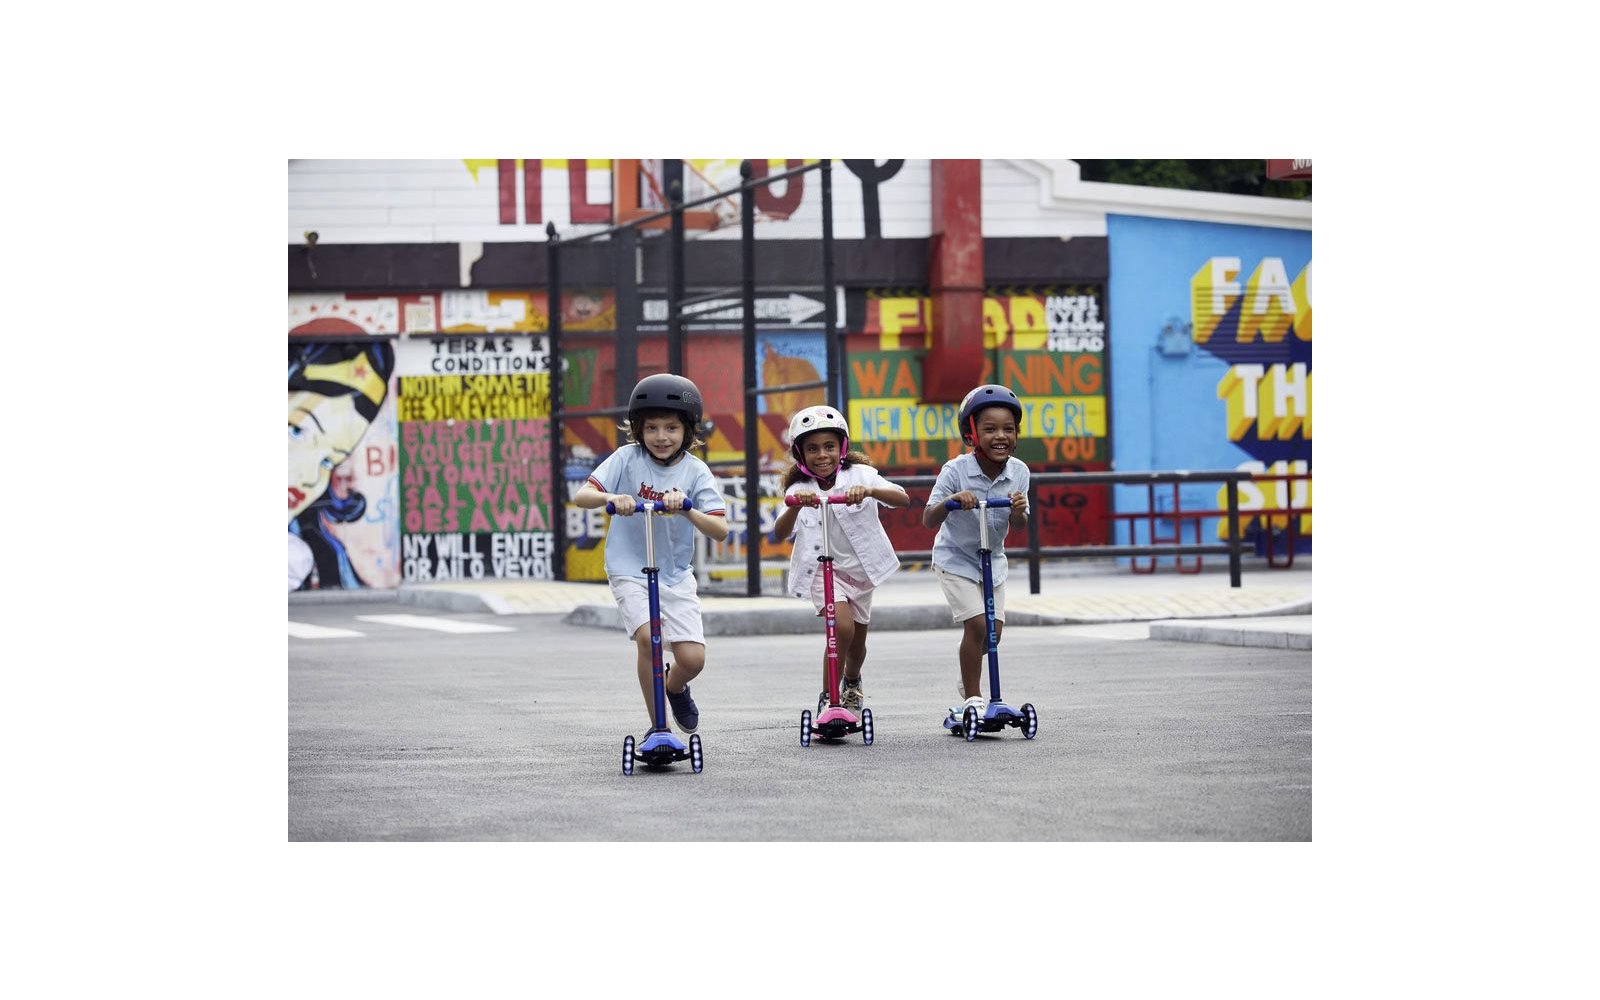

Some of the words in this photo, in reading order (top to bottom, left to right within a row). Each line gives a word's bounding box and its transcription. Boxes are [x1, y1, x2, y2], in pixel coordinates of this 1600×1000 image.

[879, 296, 1046, 350] FOD
[431, 339, 512, 354] TERMS
[531, 338, 543, 353] &
[432, 356, 550, 372] CONDITIONS
[861, 406, 900, 442] NEW
[908, 404, 960, 440] YOR
[863, 438, 937, 466] WILL
[1042, 436, 1096, 463] YOU
[470, 504, 552, 532] AWA
[403, 534, 431, 559] NY
[435, 534, 485, 559] WILL
[827, 603, 837, 648] micro
[986, 598, 997, 643] micro
